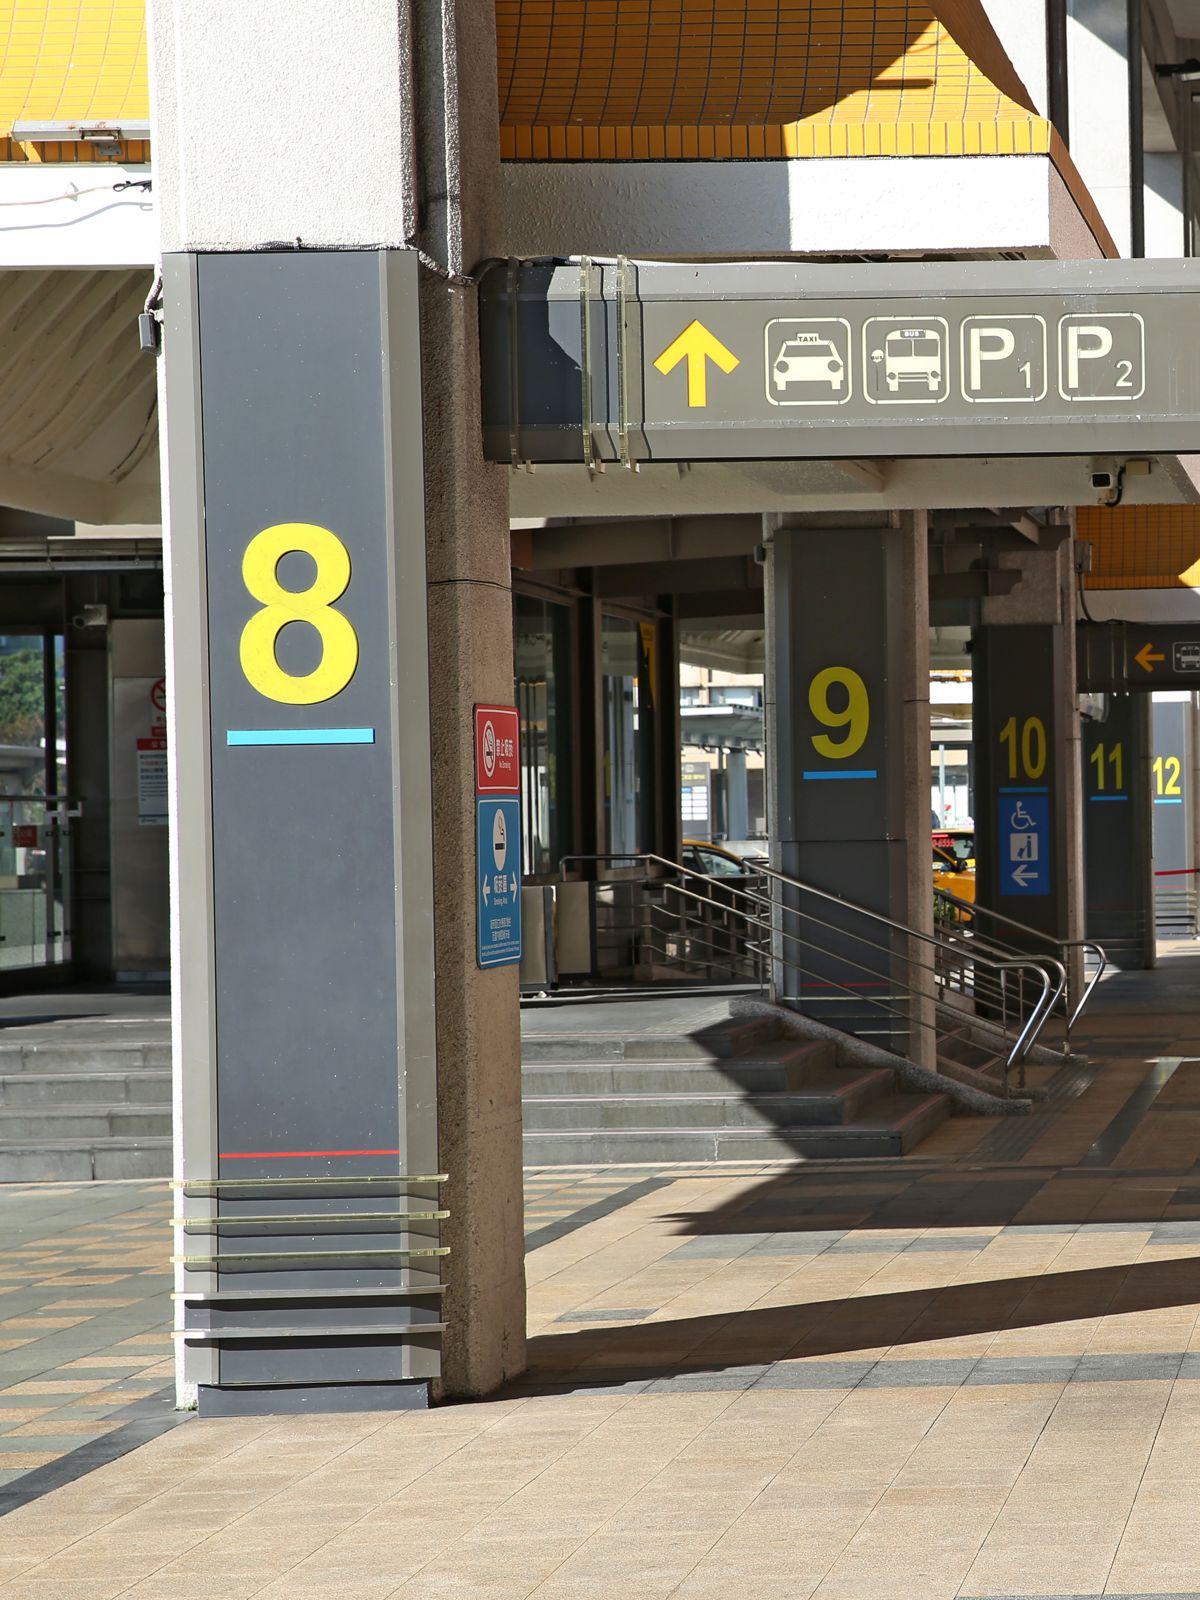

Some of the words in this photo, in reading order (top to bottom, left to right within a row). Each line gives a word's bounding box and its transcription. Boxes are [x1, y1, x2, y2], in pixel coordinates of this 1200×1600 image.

[239, 522, 359, 705] 8
[808, 666, 870, 760] 9
[1000, 716, 1047, 780] 10
[1090, 742, 1123, 790] 11
[1152, 756, 1181, 796] 12
